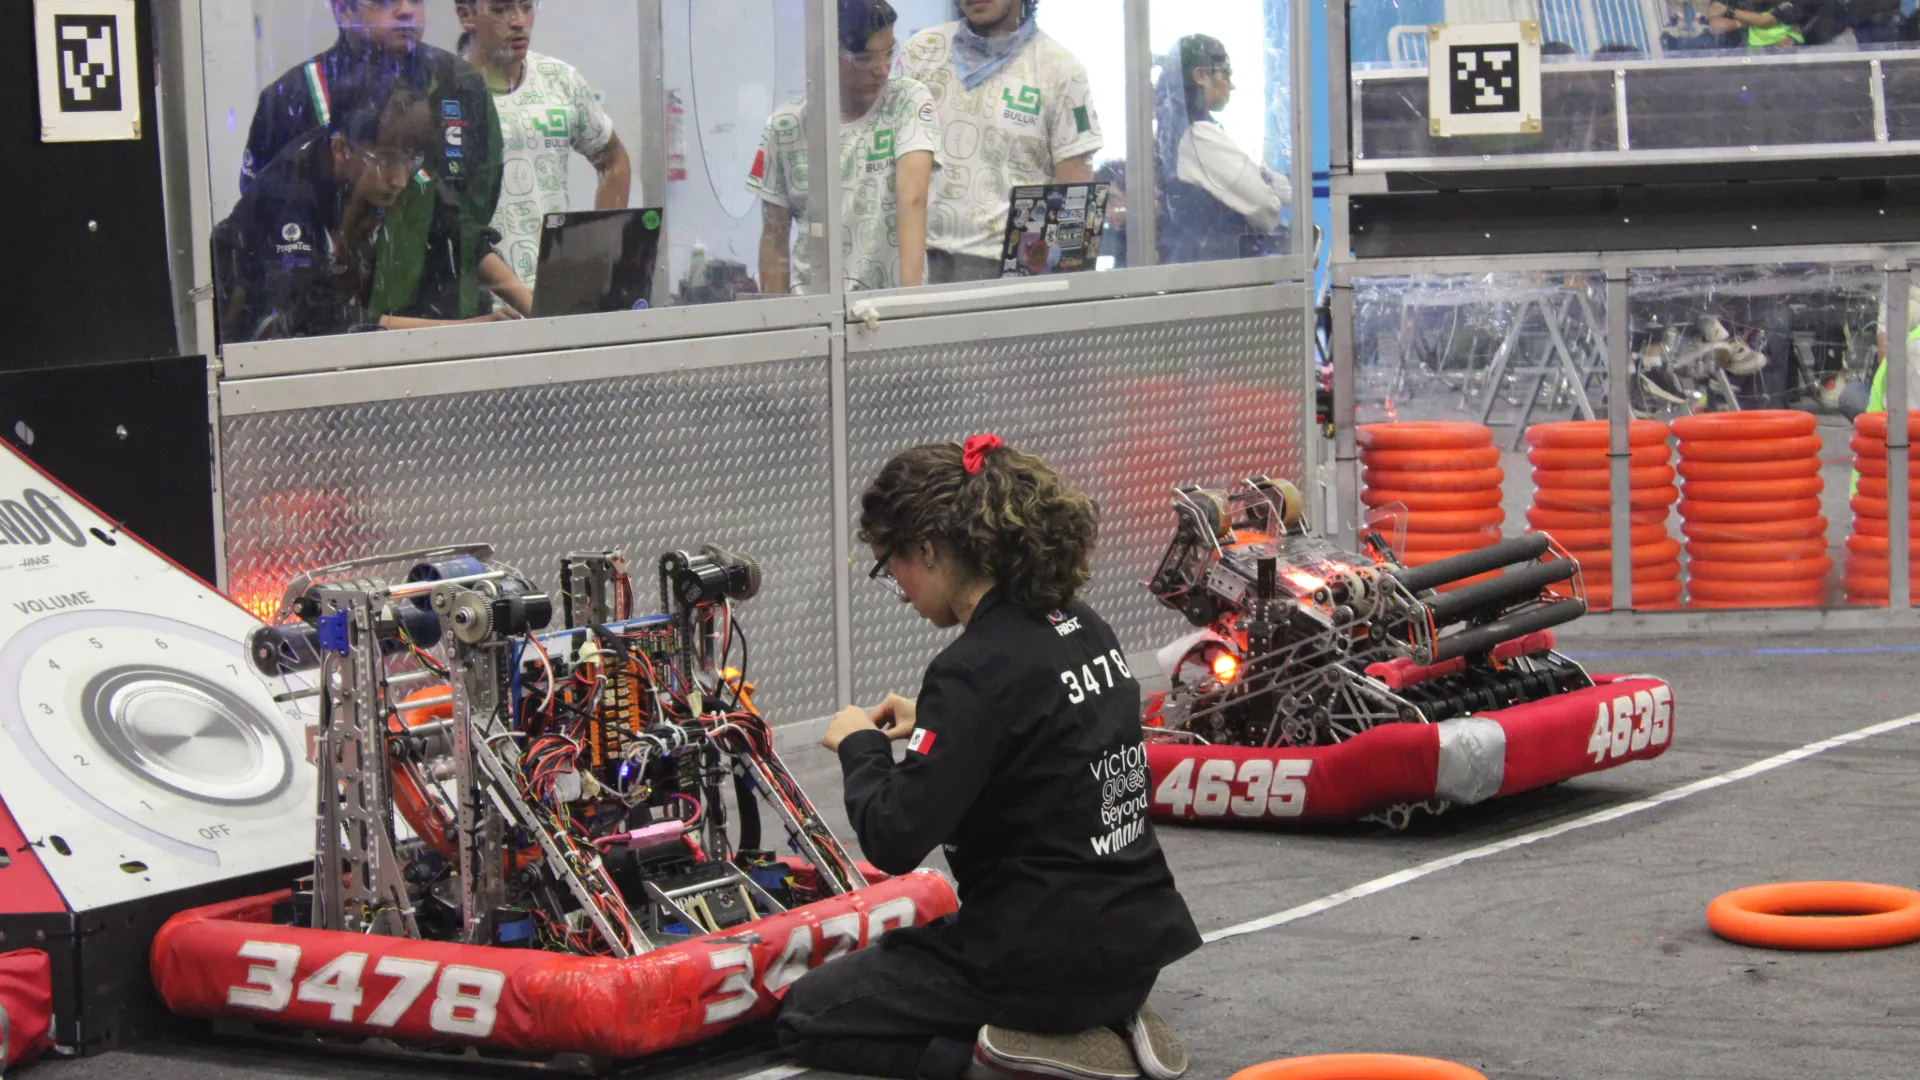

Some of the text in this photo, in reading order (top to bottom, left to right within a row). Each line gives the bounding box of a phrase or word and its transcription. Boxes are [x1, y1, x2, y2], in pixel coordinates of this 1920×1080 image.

[1003, 109, 1036, 126] BULUK
[0, 488, 87, 547] NDO
[12, 590, 95, 615] VOLUME
[1054, 616, 1082, 637] FIRST
[88, 637, 104, 649] 5
[154, 637, 169, 650] 6
[48, 658, 61, 671] 4
[226, 663, 239, 676] 7
[1061, 649, 1132, 704] 3478
[38, 702, 54, 716] 3
[1587, 684, 1671, 764] 4635
[73, 754, 90, 767] 2
[1102, 765, 1146, 809] goes
[1155, 758, 1313, 817] 4635
[140, 800, 155, 812] 1
[1101, 789, 1148, 825] beyond
[198, 823, 231, 840] OFF
[227, 940, 506, 1038] 3478
